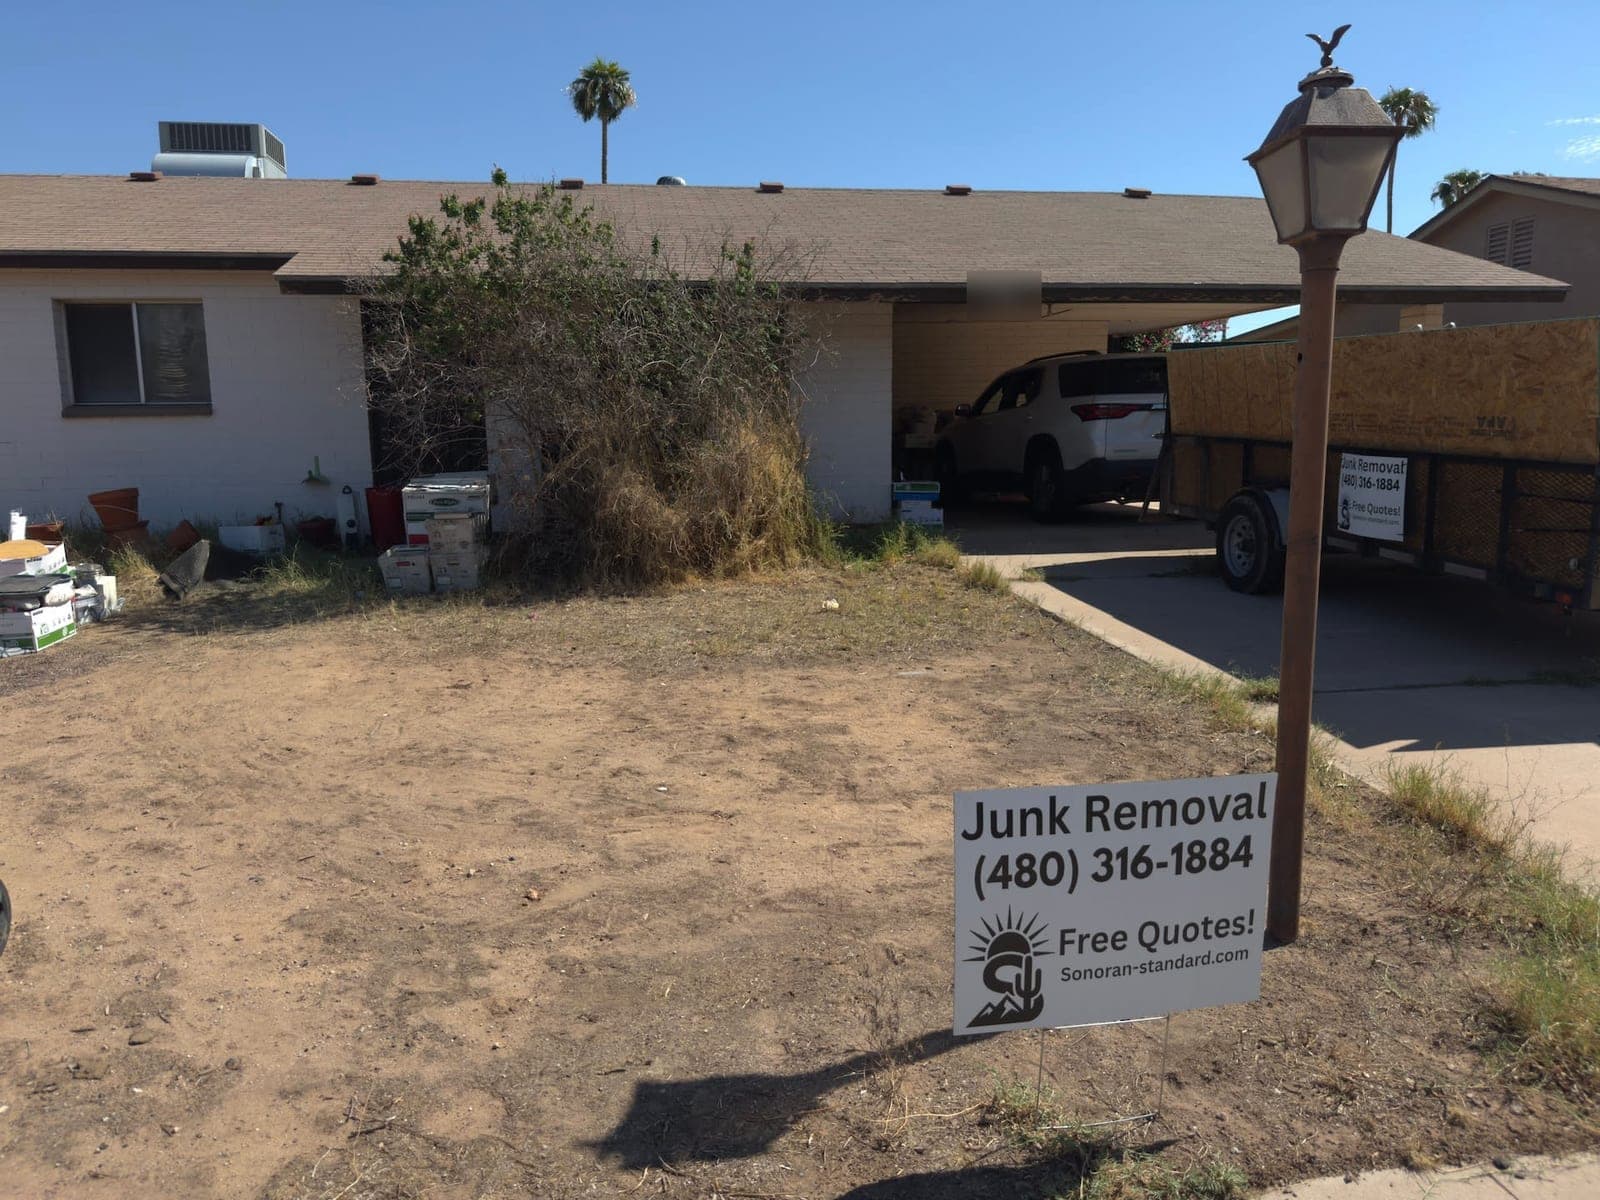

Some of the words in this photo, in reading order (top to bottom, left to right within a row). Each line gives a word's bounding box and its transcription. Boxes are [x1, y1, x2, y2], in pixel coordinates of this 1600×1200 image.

[1358, 458, 1406, 475] Removal
[1358, 475, 1400, 491] 316-1884
[1367, 503, 1401, 517] Quotes!
[961, 795, 1071, 841] Junk
[1085, 781, 1267, 833] Removal
[974, 848, 1079, 902] (480)
[1091, 835, 1254, 883] 316-1884
[1059, 927, 1129, 956] Free
[1137, 908, 1255, 954] Quotes!
[1060, 948, 1250, 982] Sonoran-standard.com
